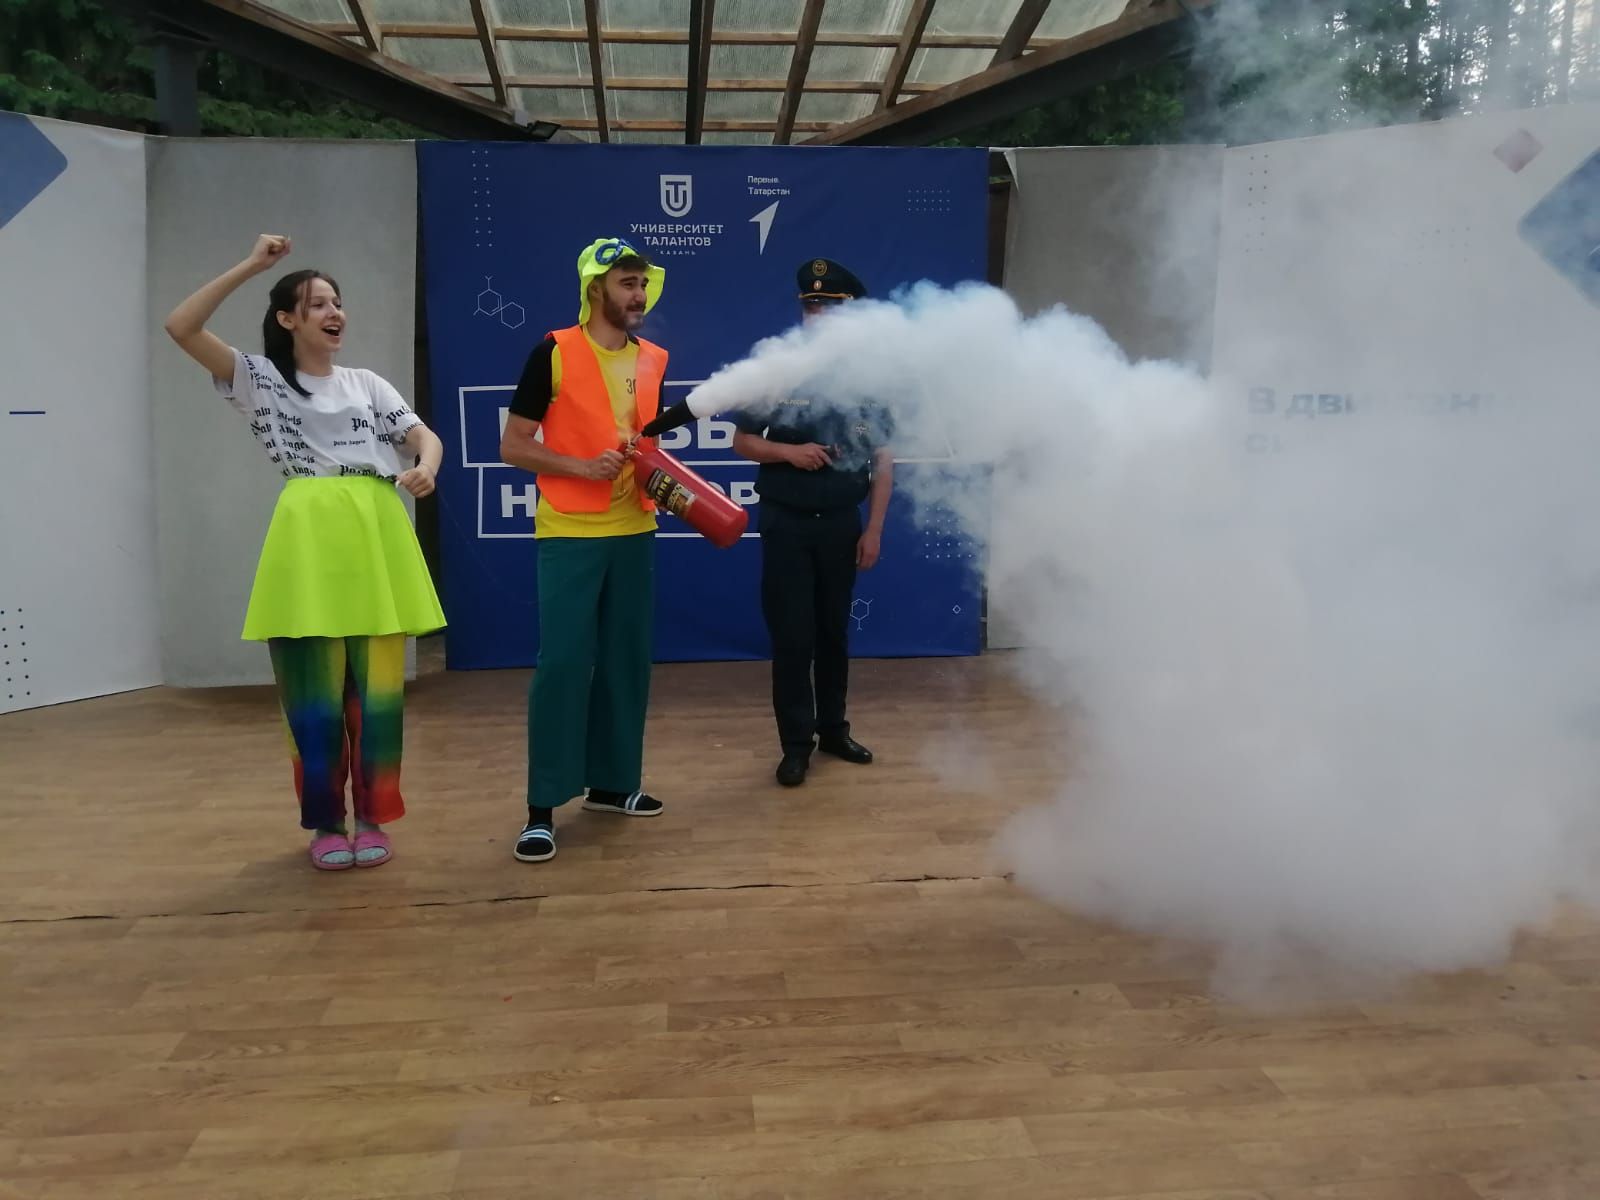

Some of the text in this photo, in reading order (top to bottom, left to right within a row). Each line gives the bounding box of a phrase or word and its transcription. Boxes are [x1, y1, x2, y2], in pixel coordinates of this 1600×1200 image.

[747, 175, 779, 186] Первые
[747, 187, 791, 197] Татарстан
[630, 223, 724, 234] УНИВЕРСИТЕТ
[643, 236, 712, 247] ТАЛАНТОВ
